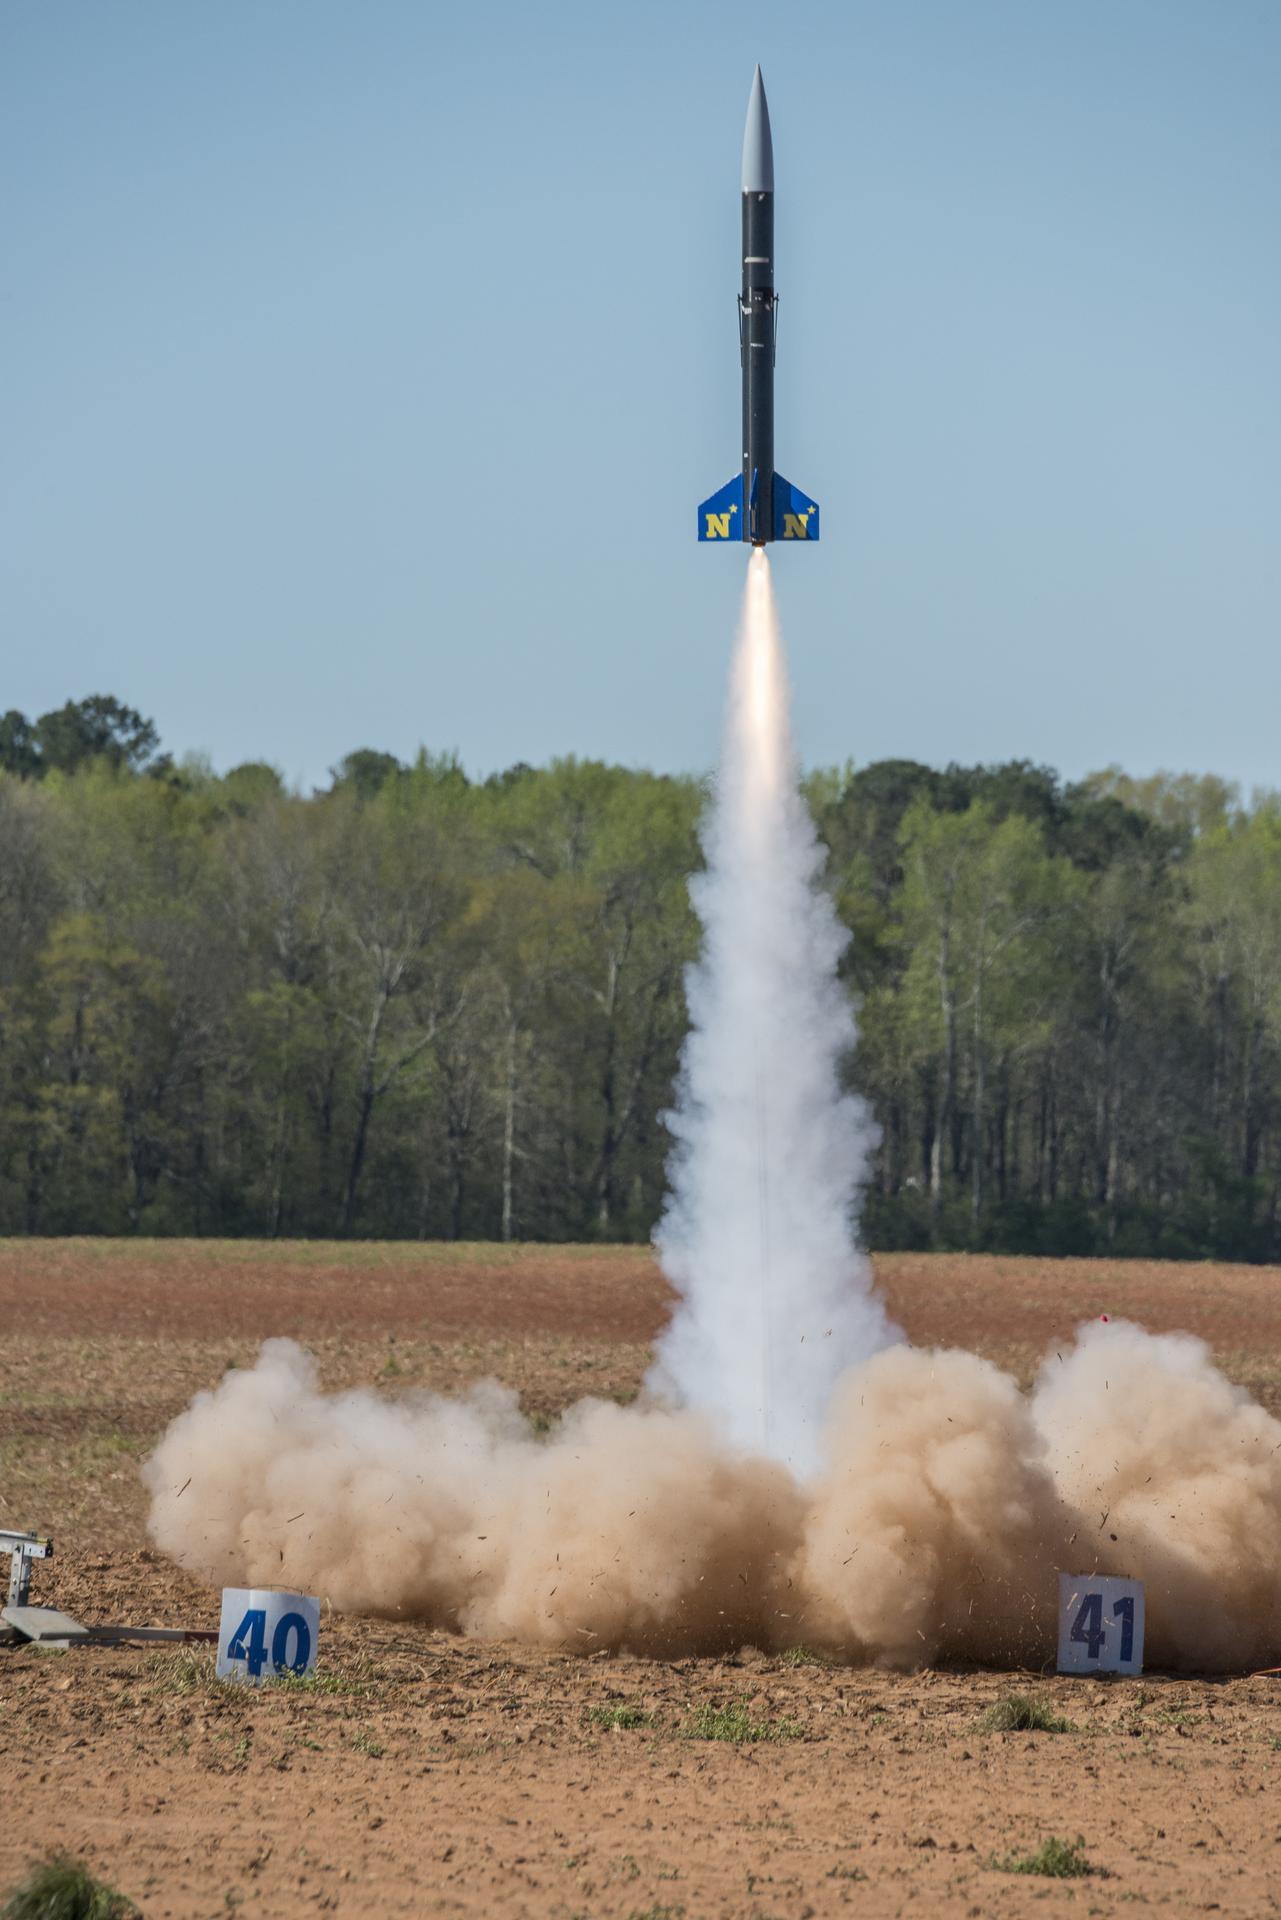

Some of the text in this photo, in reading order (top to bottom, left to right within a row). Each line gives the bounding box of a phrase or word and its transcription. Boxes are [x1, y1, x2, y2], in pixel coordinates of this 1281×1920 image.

[706, 513, 730, 538] N
[784, 514, 808, 538] N
[227, 1609, 310, 1680] 40
[1070, 1594, 1134, 1662] 41
